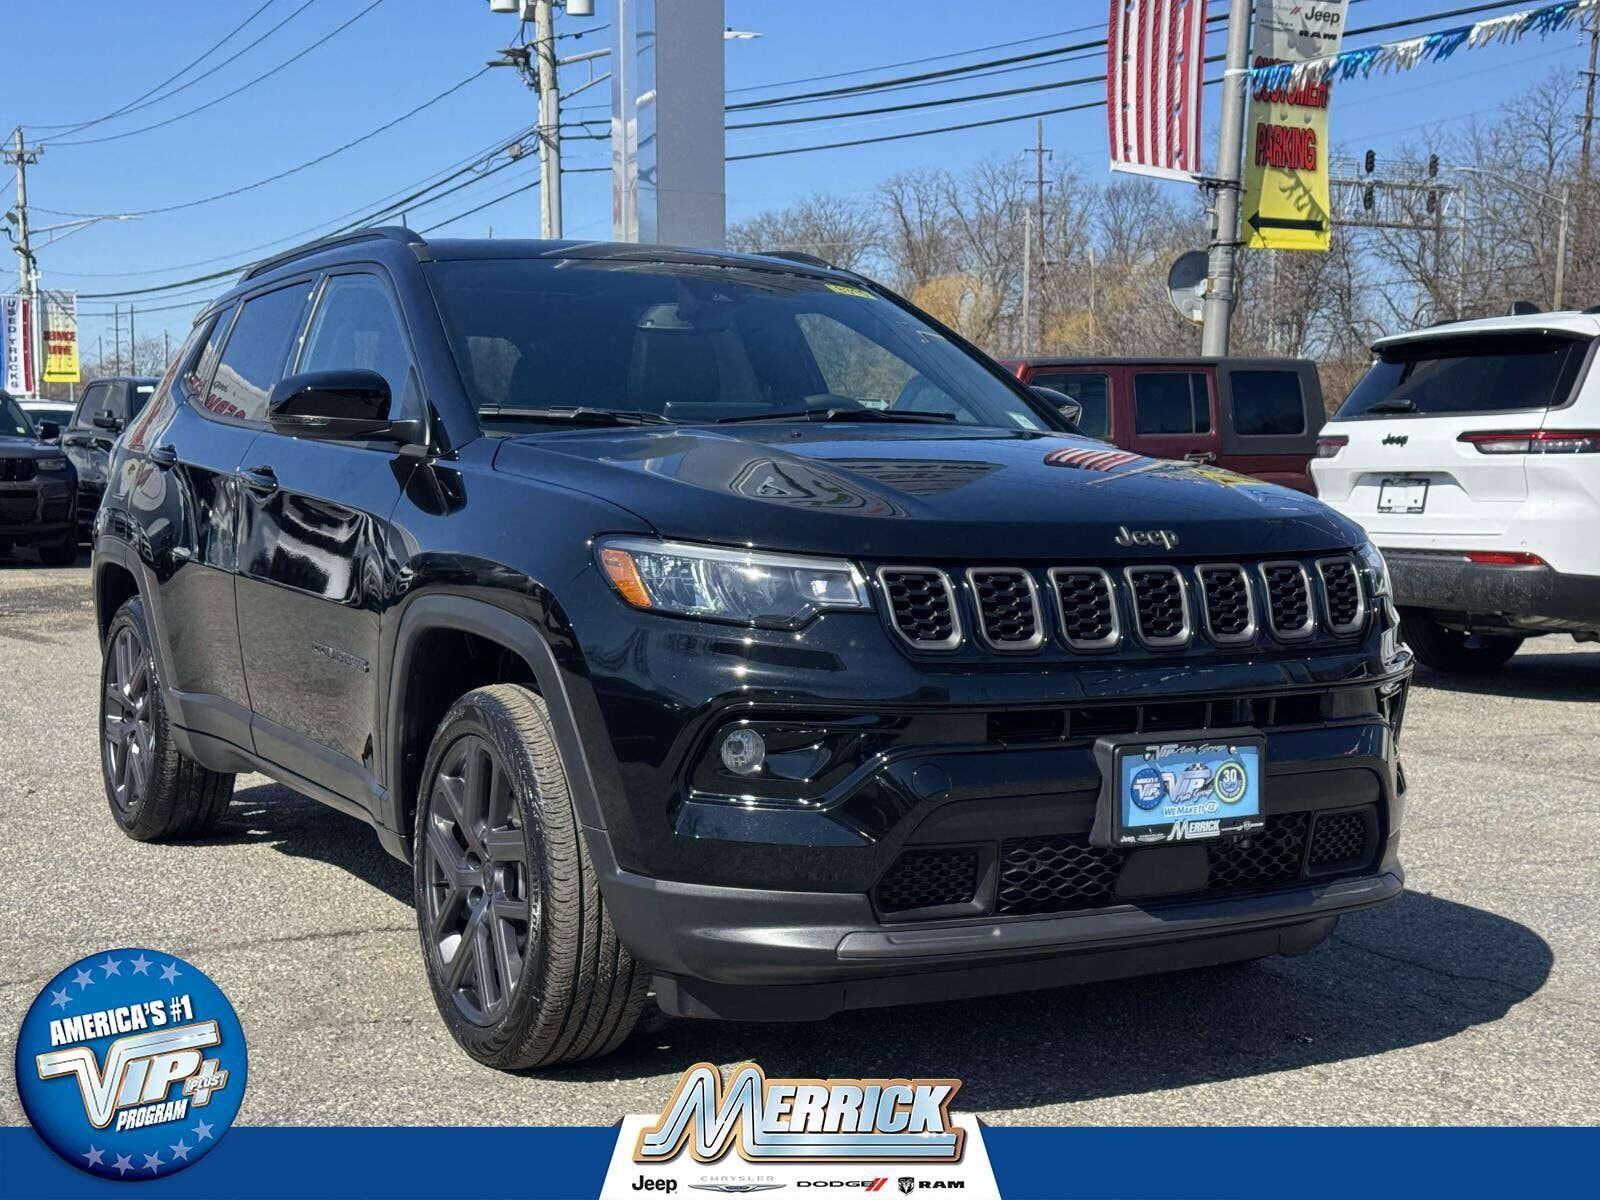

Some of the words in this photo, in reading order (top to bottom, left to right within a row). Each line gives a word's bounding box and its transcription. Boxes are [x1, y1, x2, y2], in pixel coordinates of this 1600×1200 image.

[1305, 6, 1340, 26] Jeep
[1299, 30, 1337, 41] RAM
[1255, 122, 1317, 170] PARKING
[1115, 525, 1179, 550] Jeep
[1161, 768, 1211, 803] VIP
[1223, 768, 1238, 783] 30
[1167, 819, 1220, 841] MERRICK
